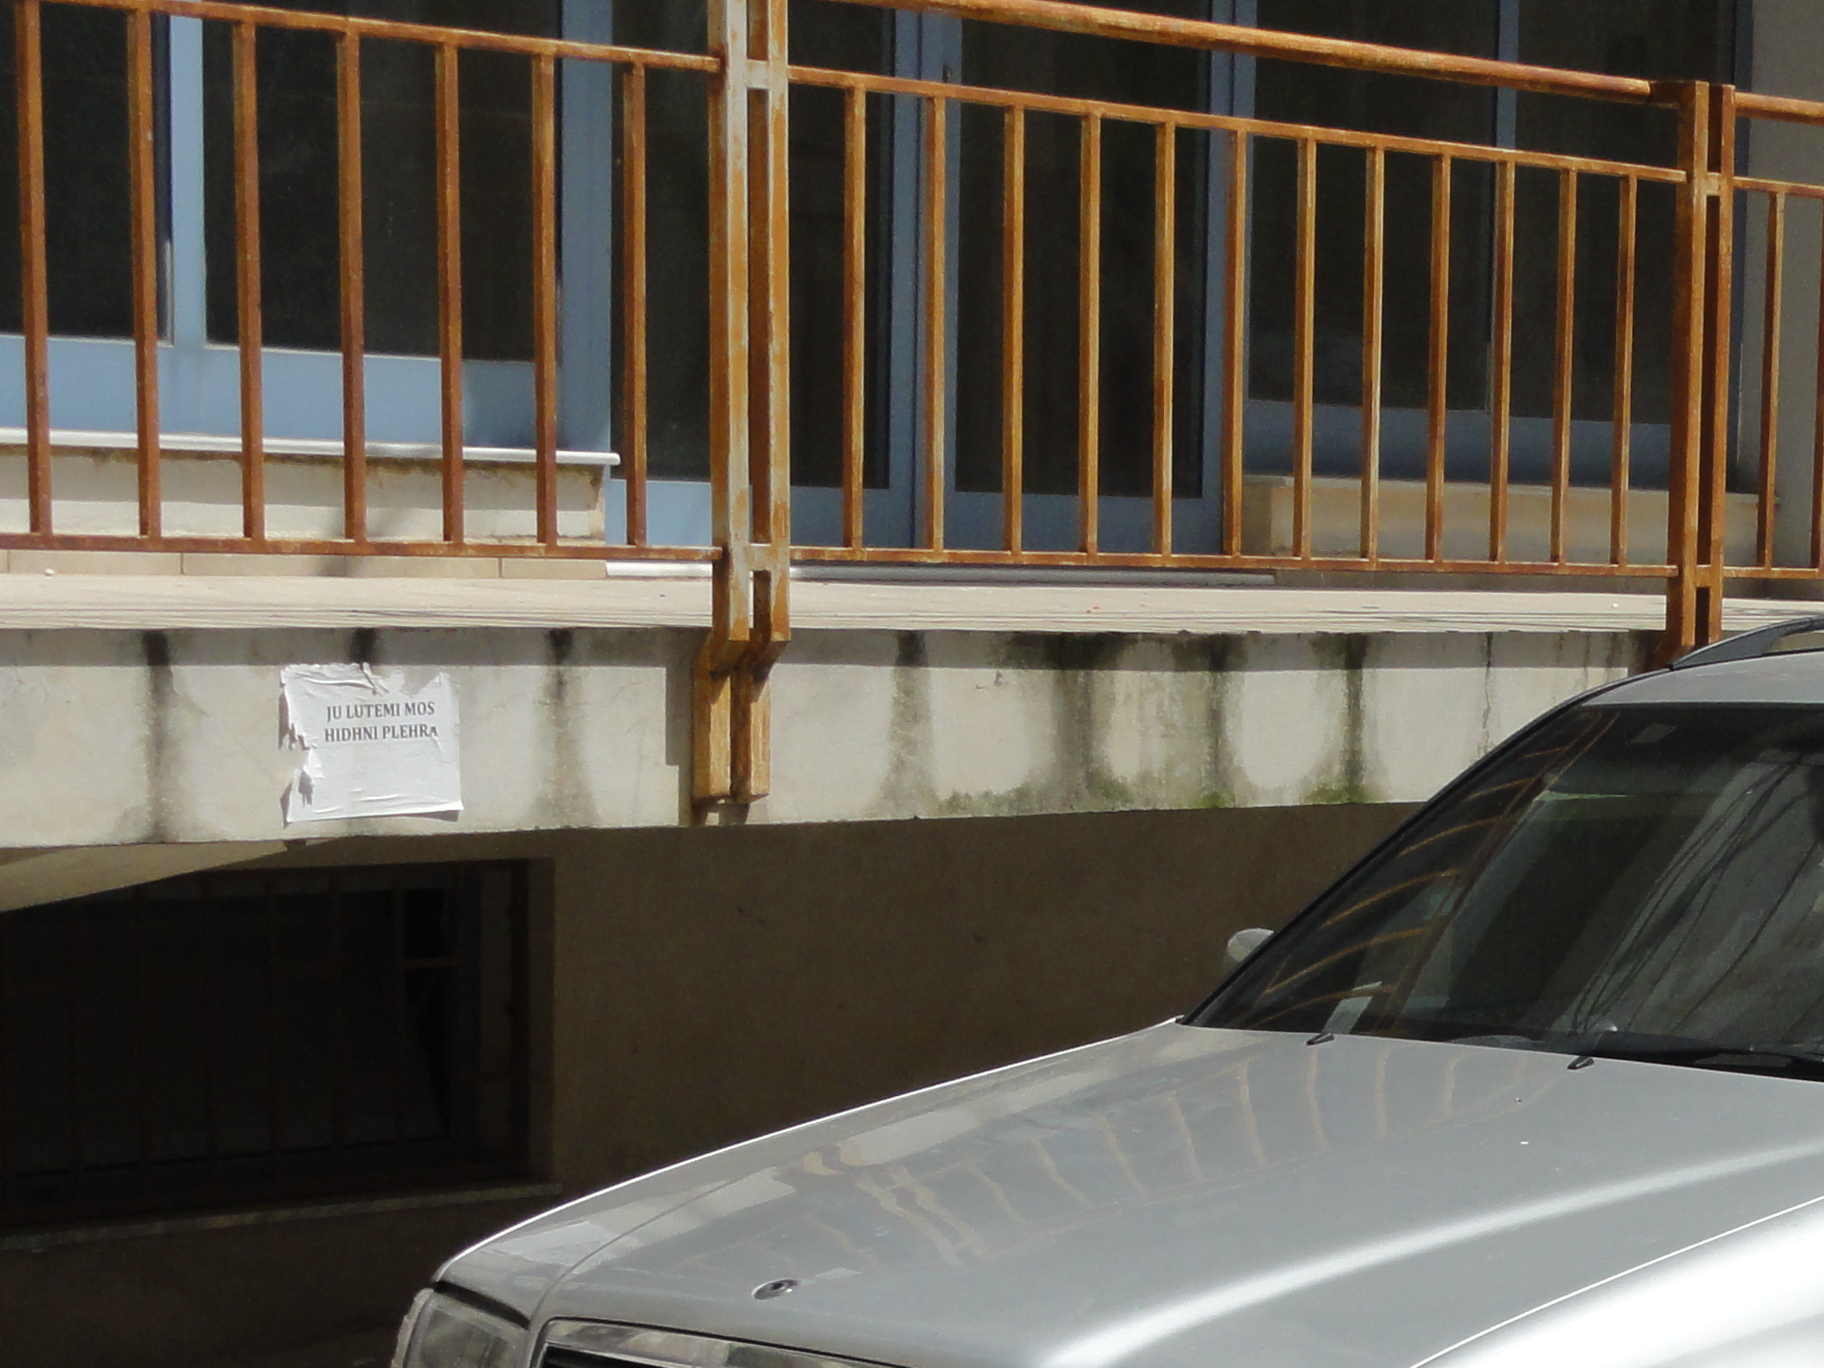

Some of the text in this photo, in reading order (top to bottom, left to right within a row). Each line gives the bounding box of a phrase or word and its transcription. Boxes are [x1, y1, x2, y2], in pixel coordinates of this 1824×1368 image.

[326, 701, 435, 723] JU LUTEMI MOS
[324, 724, 439, 743] HIDHNI PLEHRA
